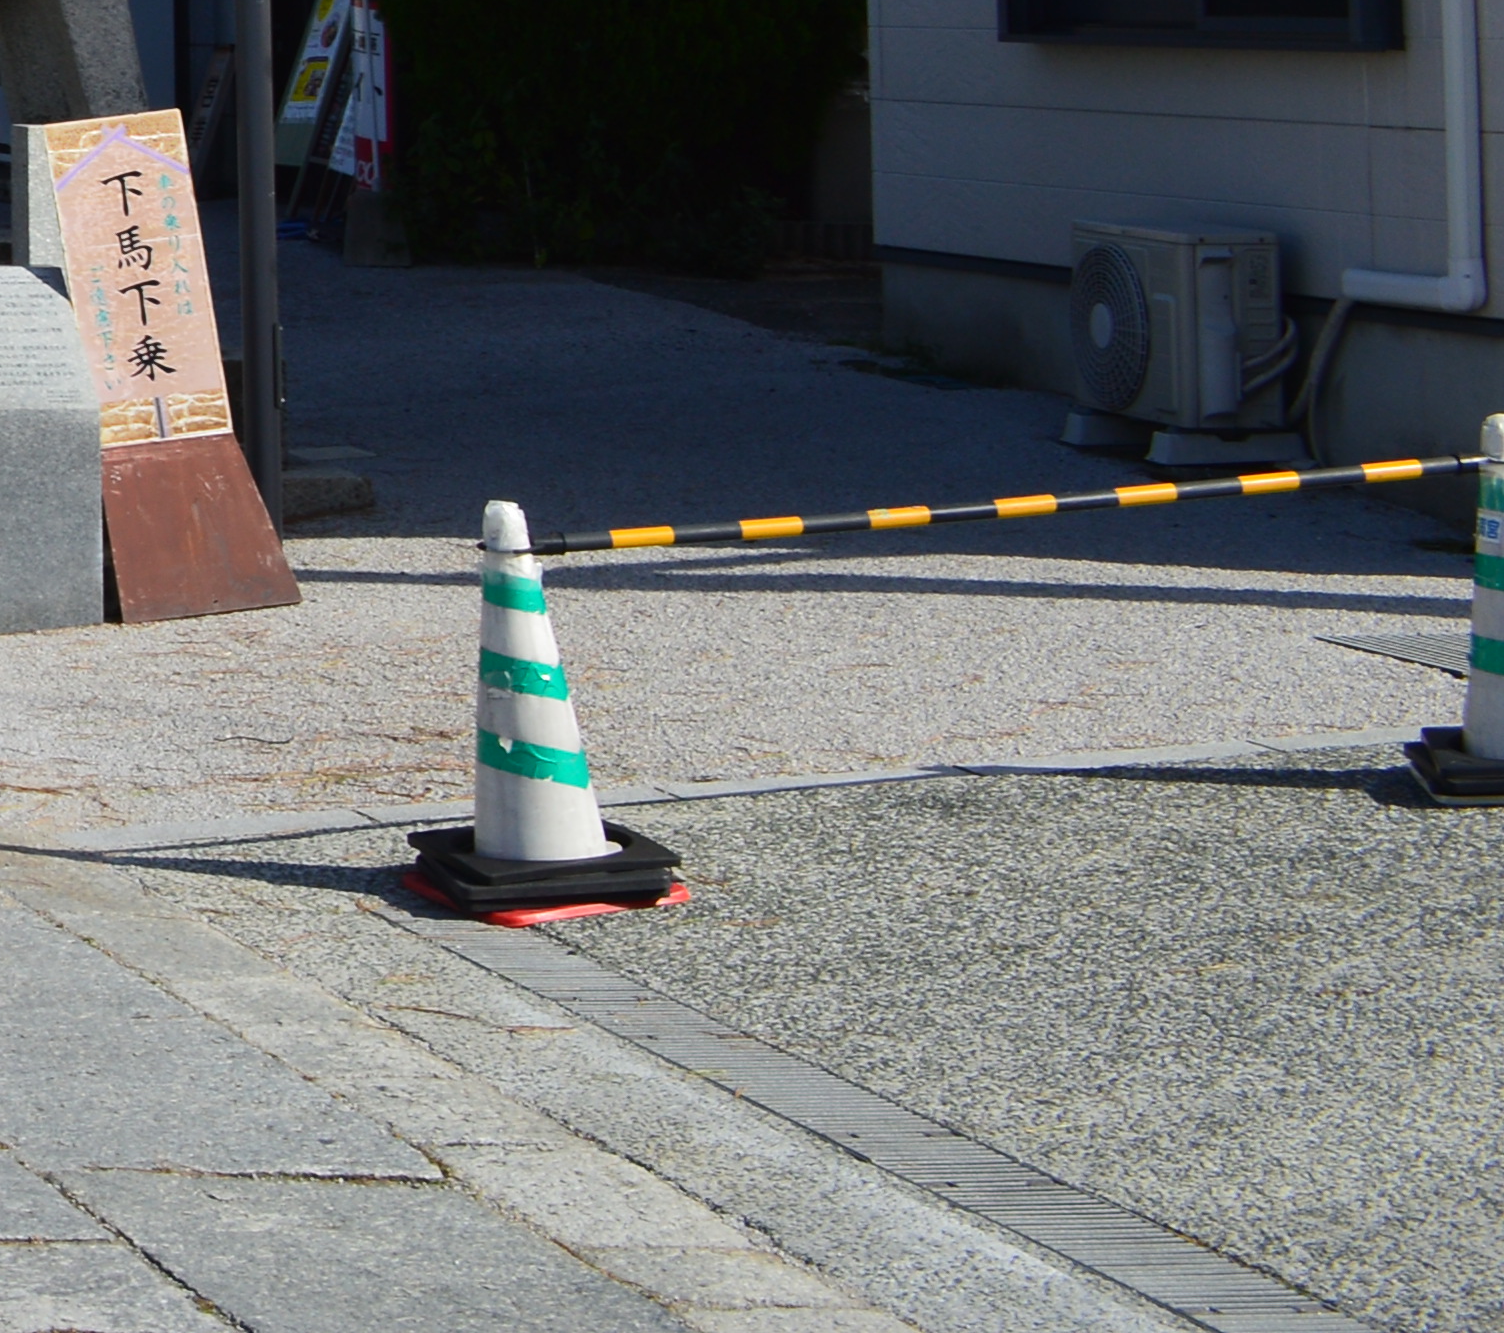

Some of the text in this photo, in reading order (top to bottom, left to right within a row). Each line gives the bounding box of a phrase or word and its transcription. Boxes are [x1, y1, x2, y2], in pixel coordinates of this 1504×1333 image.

[101, 170, 176, 382] 下馬下乗
[156, 173, 195, 316] 車の乗り入れは
